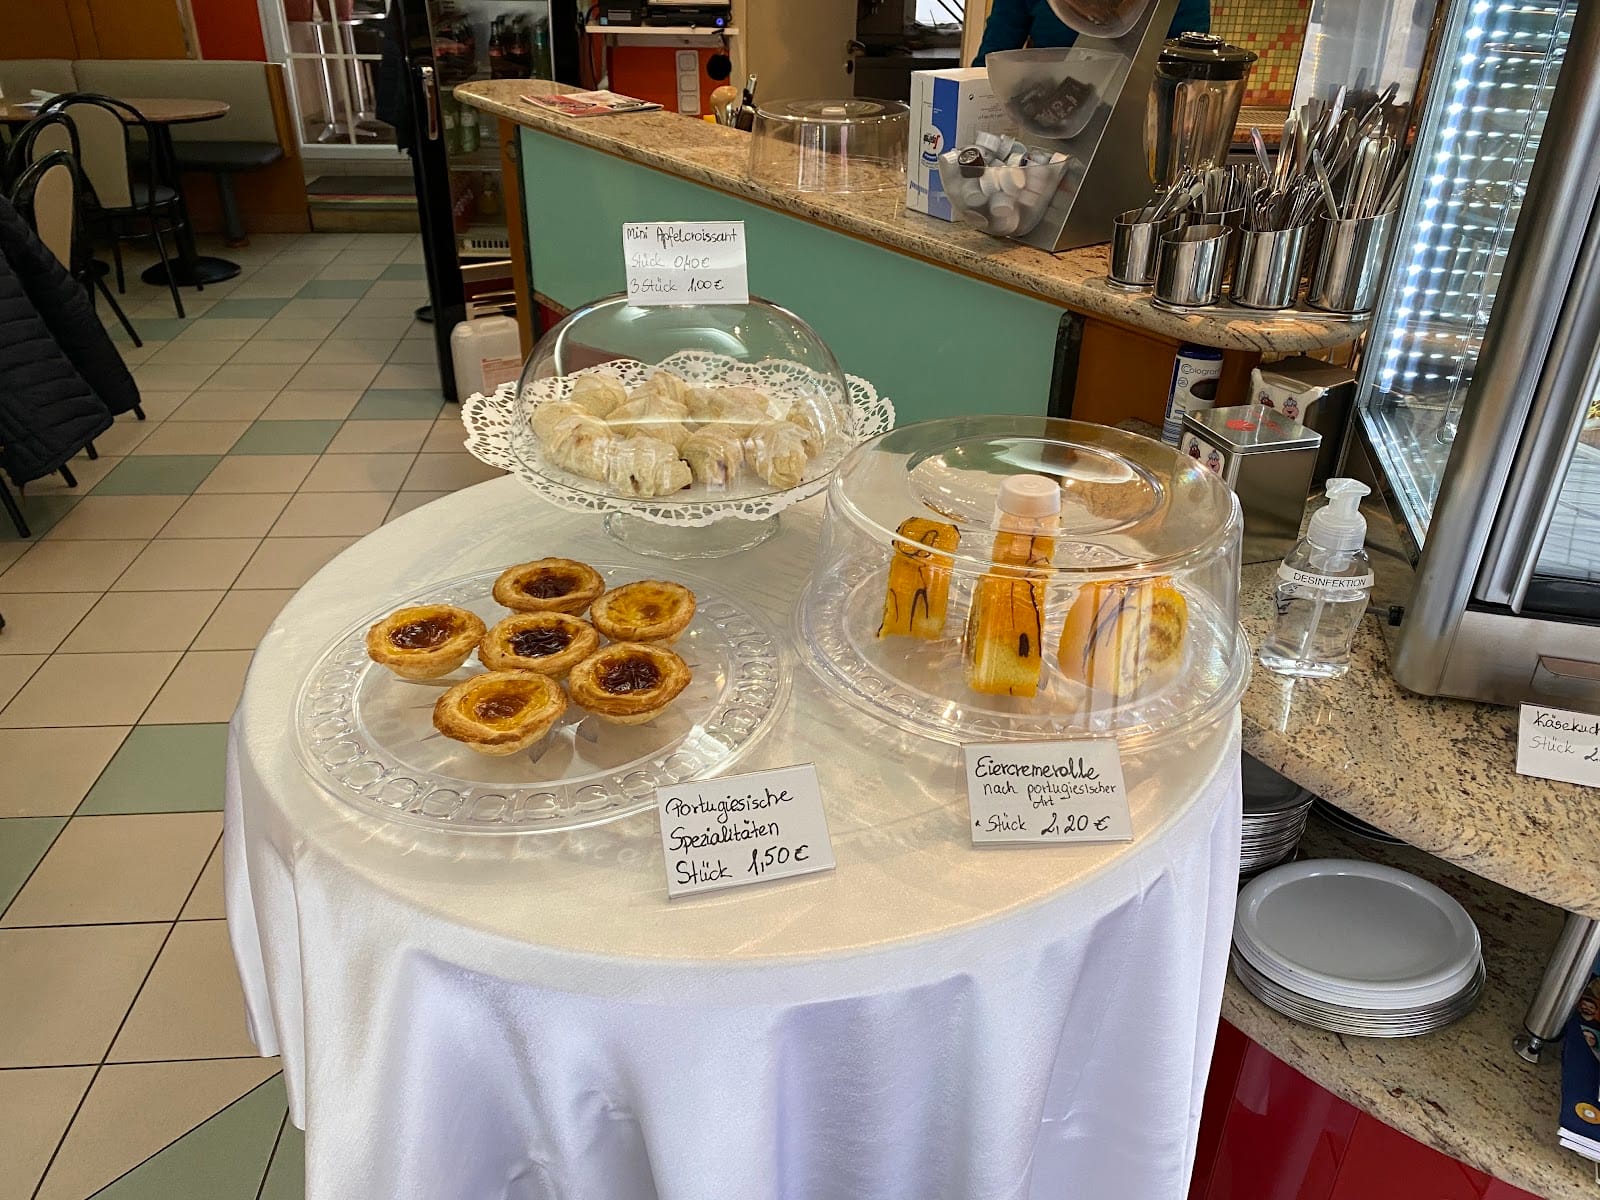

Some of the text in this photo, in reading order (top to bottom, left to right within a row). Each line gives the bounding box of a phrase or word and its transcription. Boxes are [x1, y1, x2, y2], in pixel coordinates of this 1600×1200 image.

[656, 226, 737, 249] Apfelcroissant
[631, 252, 665, 268] Stück
[641, 277, 678, 292] Stück
[1293, 572, 1367, 588] DESINFEKTION
[1528, 736, 1575, 753] Stück
[975, 755, 1100, 780] Eiercremerolle
[983, 781, 1117, 800] nach portugiesischer
[665, 788, 794, 824] Portugiesische
[1033, 796, 1055, 809] Art
[985, 812, 1027, 832] Stück
[669, 819, 779, 854] Spezialitäten
[675, 860, 733, 884] Stück
